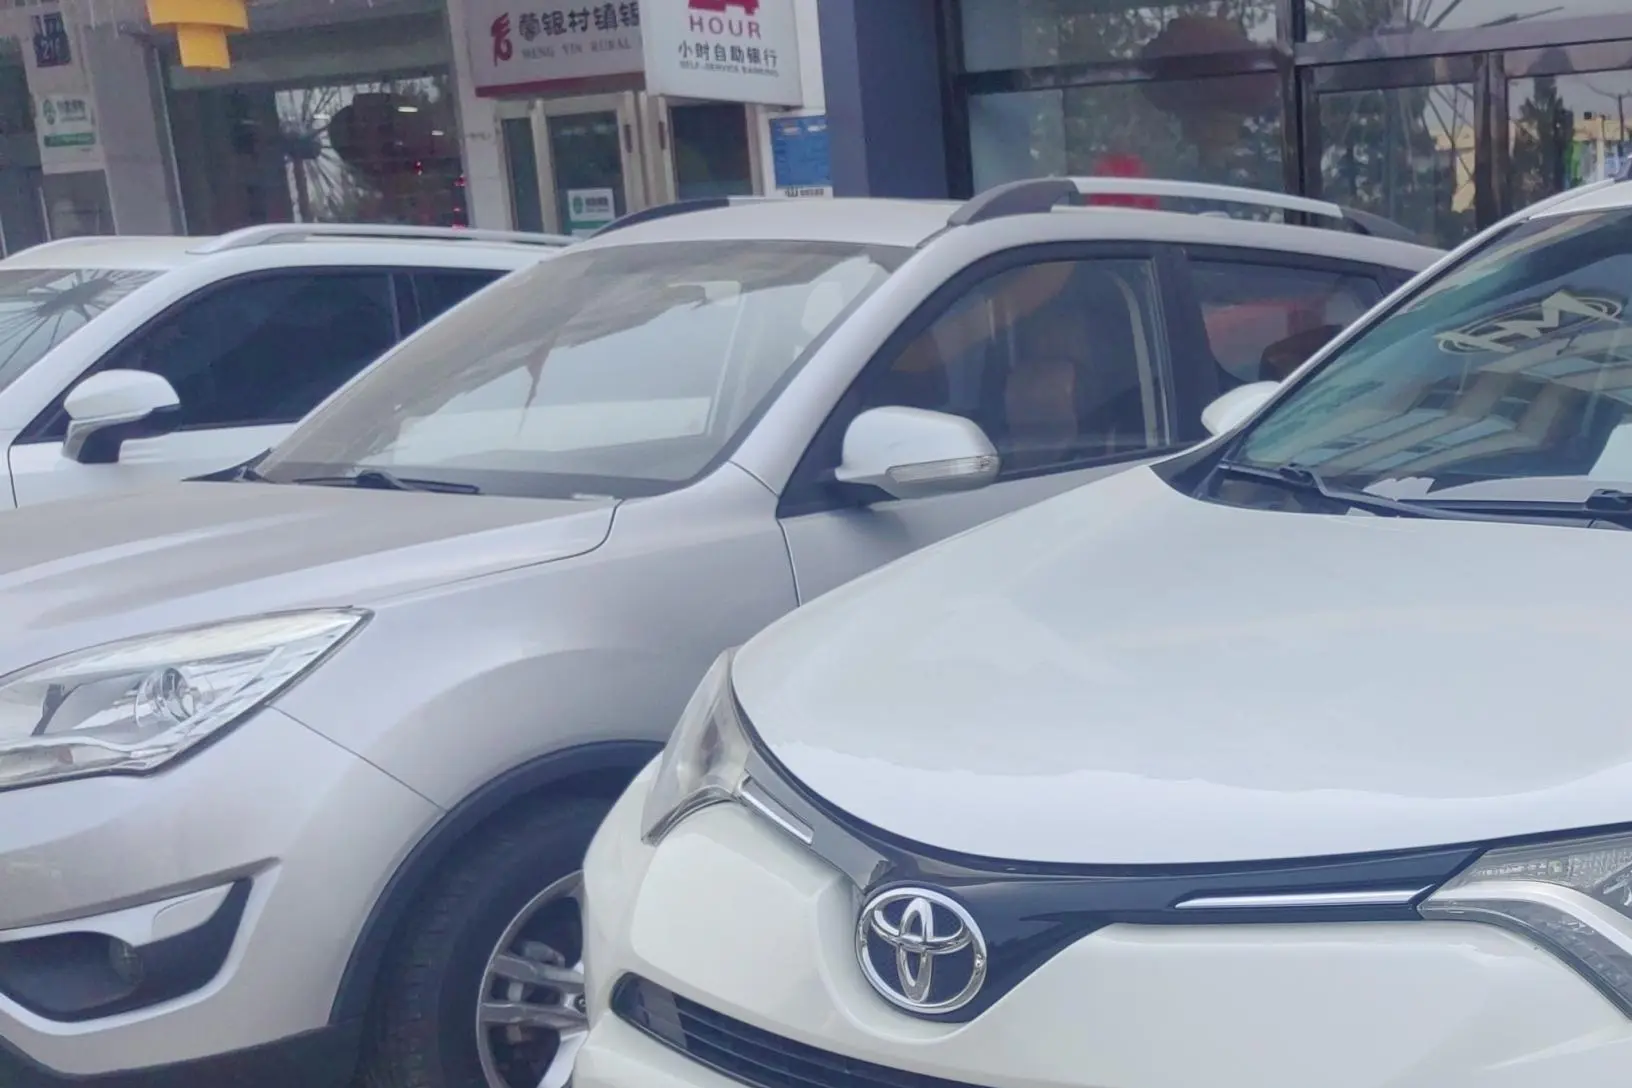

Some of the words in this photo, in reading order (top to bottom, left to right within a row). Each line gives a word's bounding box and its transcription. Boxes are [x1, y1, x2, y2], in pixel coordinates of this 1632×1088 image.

[688, 14, 761, 40] HOUR
[678, 40, 777, 68] 小时自助银行
